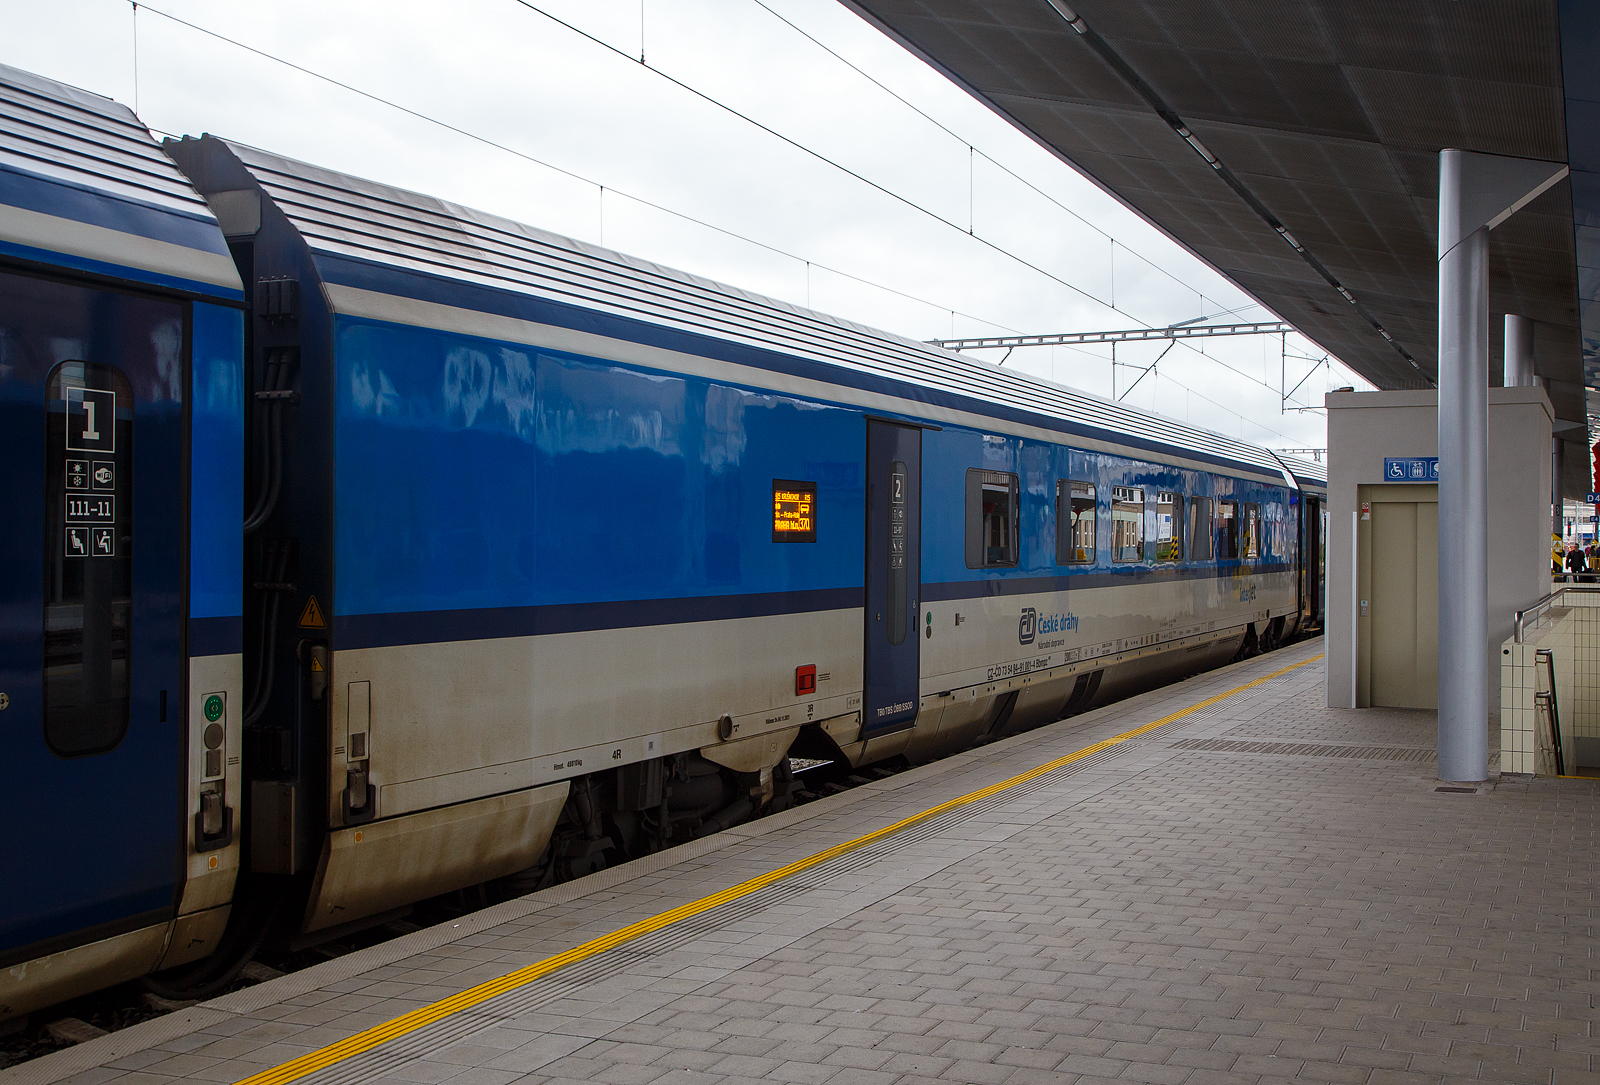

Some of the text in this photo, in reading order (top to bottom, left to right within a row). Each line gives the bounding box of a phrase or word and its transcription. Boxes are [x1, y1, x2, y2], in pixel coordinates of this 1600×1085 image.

[82, 401, 99, 440] 1
[895, 479, 901, 498] 2
[69, 500, 111, 517] 111-11
[800, 517, 811, 531] 370
[1038, 612, 1079, 635] České dráhy
[1037, 639, 1065, 650] Národní dopravce
[612, 749, 622, 760] 4R
